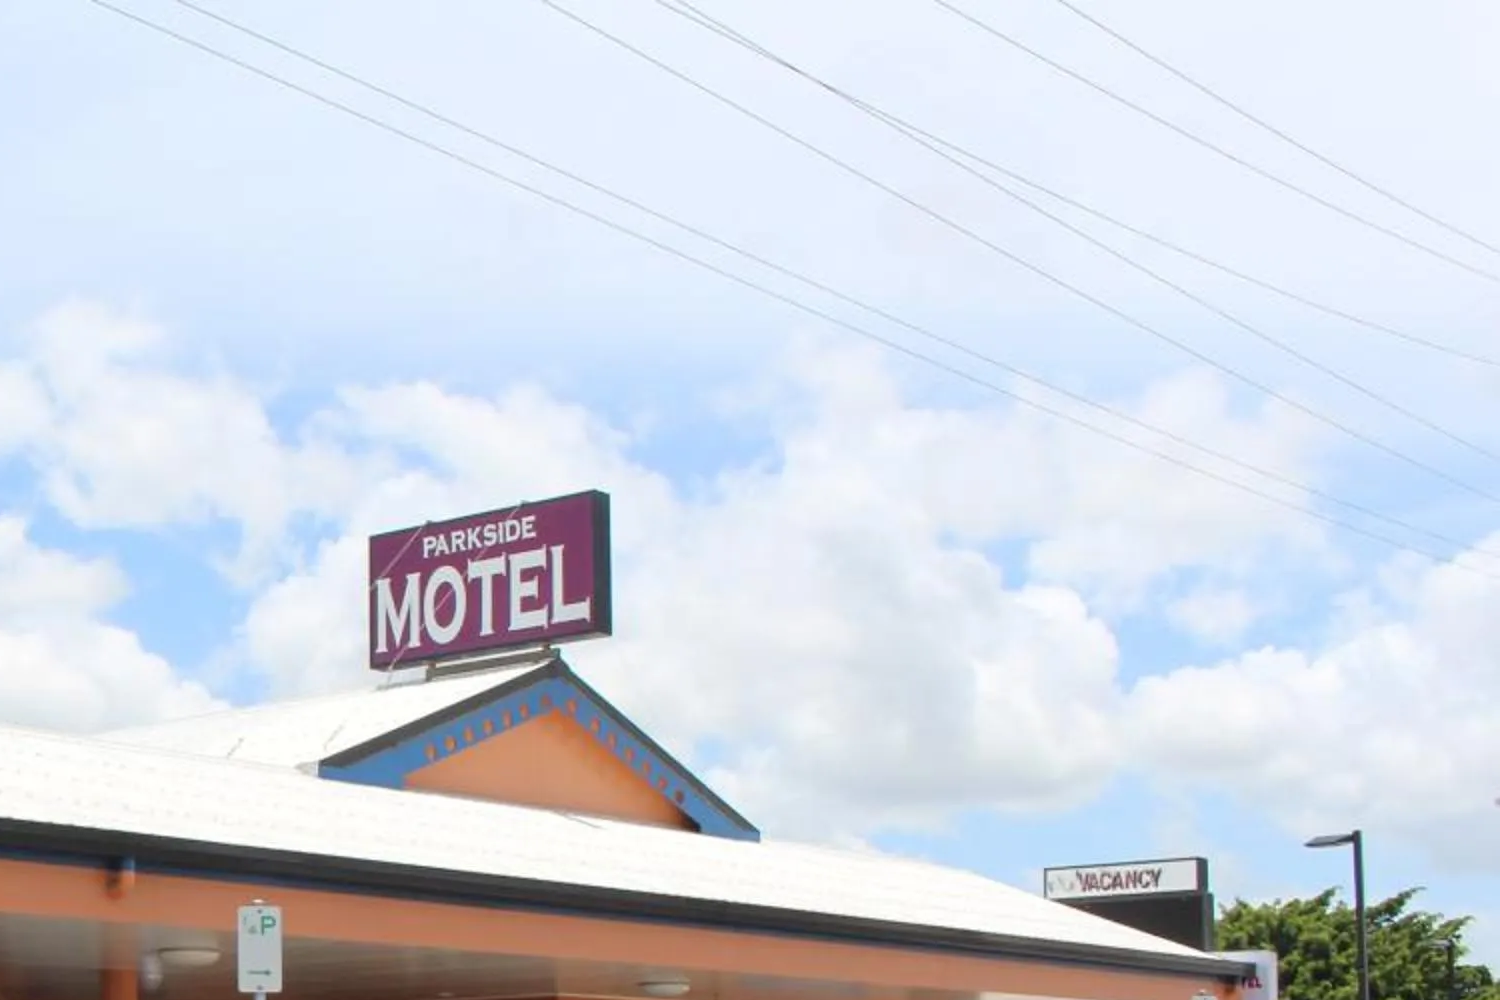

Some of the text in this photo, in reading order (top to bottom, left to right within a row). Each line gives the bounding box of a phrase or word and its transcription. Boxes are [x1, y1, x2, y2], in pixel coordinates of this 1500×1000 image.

[423, 515, 537, 558] PARKSIDE
[375, 544, 592, 653] MOTEL
[1077, 868, 1162, 892] VACANCY
